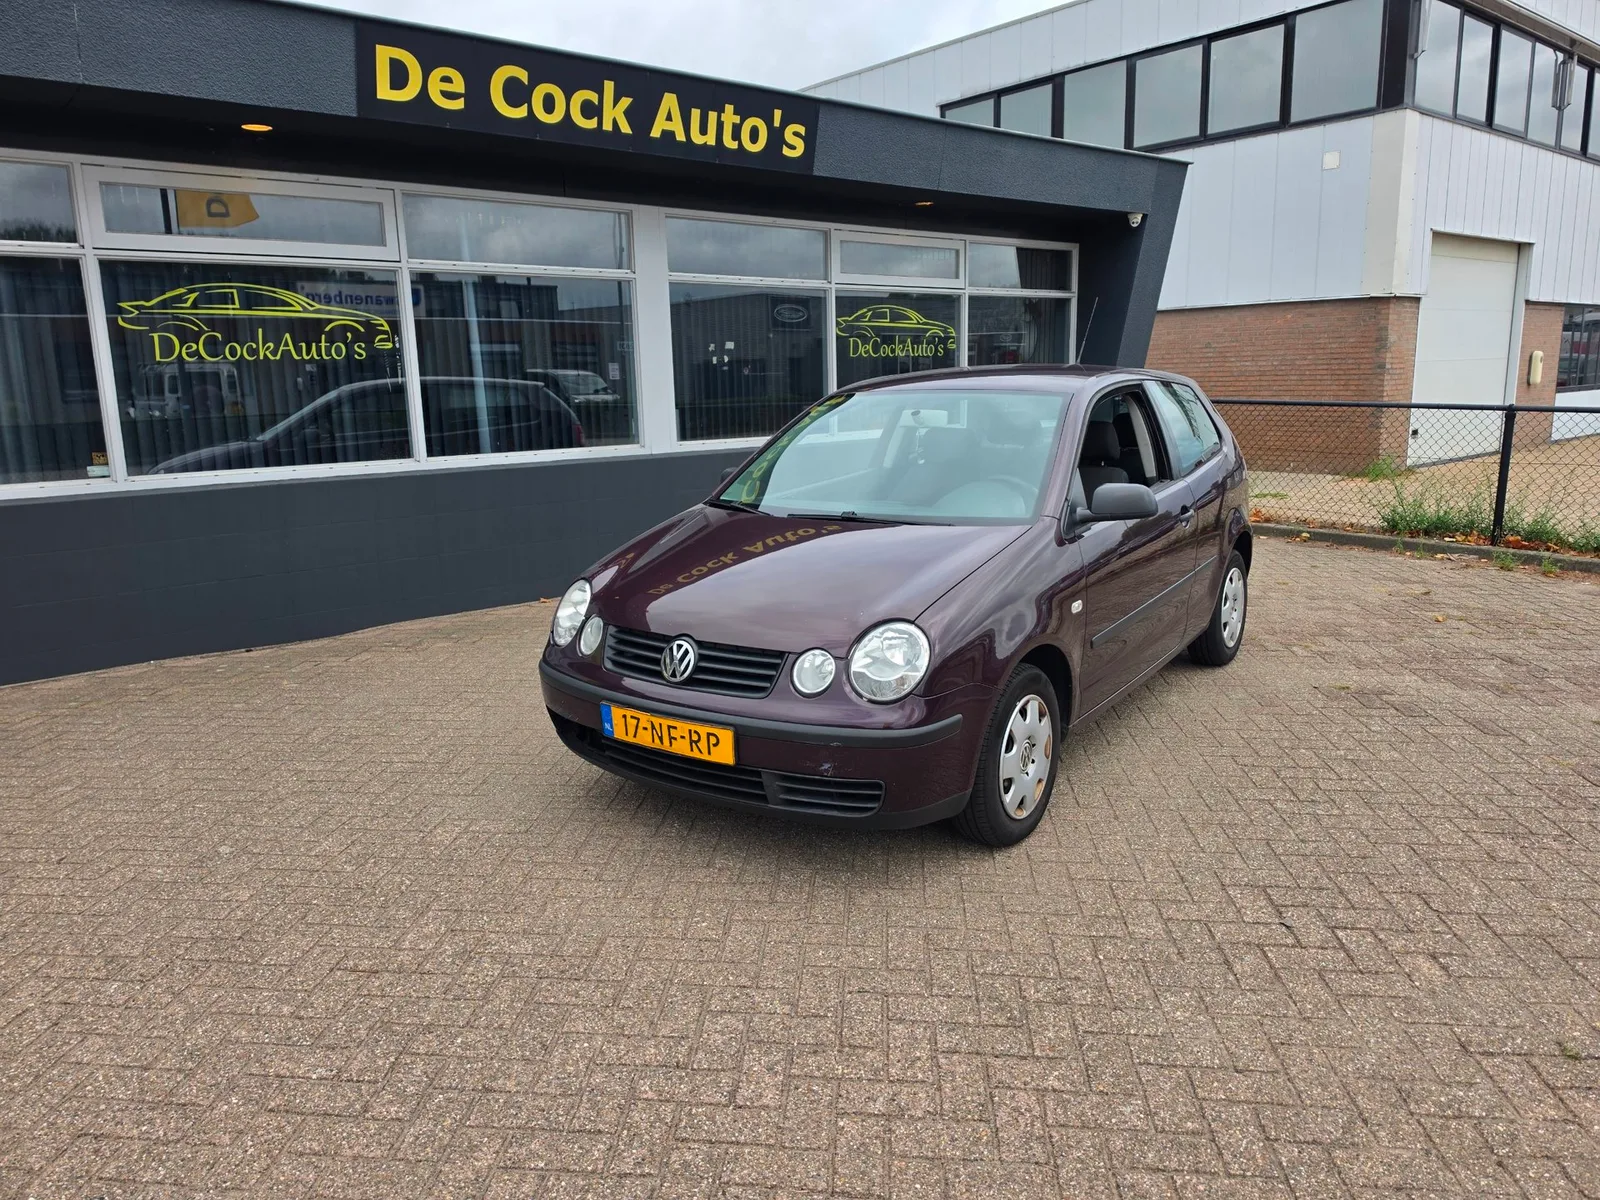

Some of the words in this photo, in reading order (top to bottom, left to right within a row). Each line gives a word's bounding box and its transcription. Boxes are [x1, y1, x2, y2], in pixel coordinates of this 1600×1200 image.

[375, 44, 466, 110] De
[489, 65, 633, 135] Cock
[649, 92, 807, 158] Auto's
[604, 722, 613, 731] NL
[621, 713, 720, 756] 17-NF-RP
